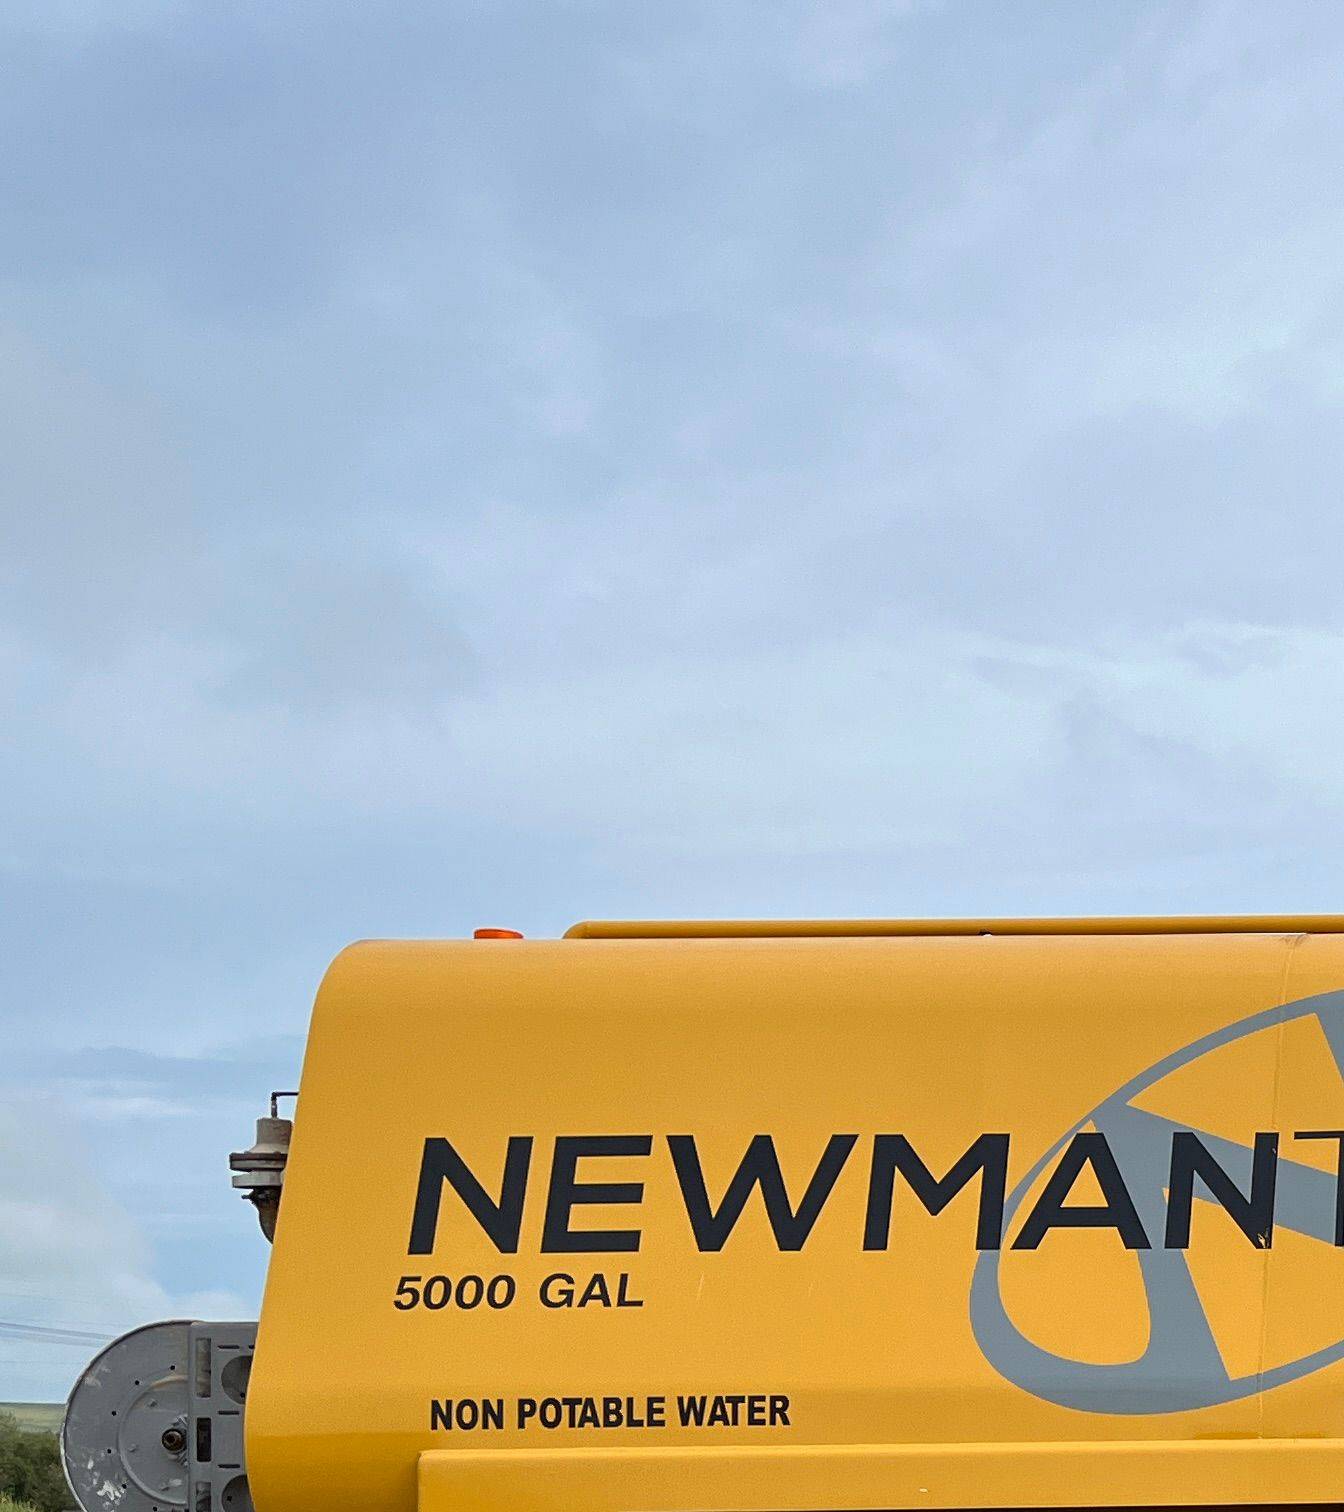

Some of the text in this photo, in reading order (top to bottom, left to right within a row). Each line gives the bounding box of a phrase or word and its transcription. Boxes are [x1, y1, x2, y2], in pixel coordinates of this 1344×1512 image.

[393, 1273, 645, 1310] 5000 GAL
[429, 1395, 791, 1431] NON POTABLE WATER
